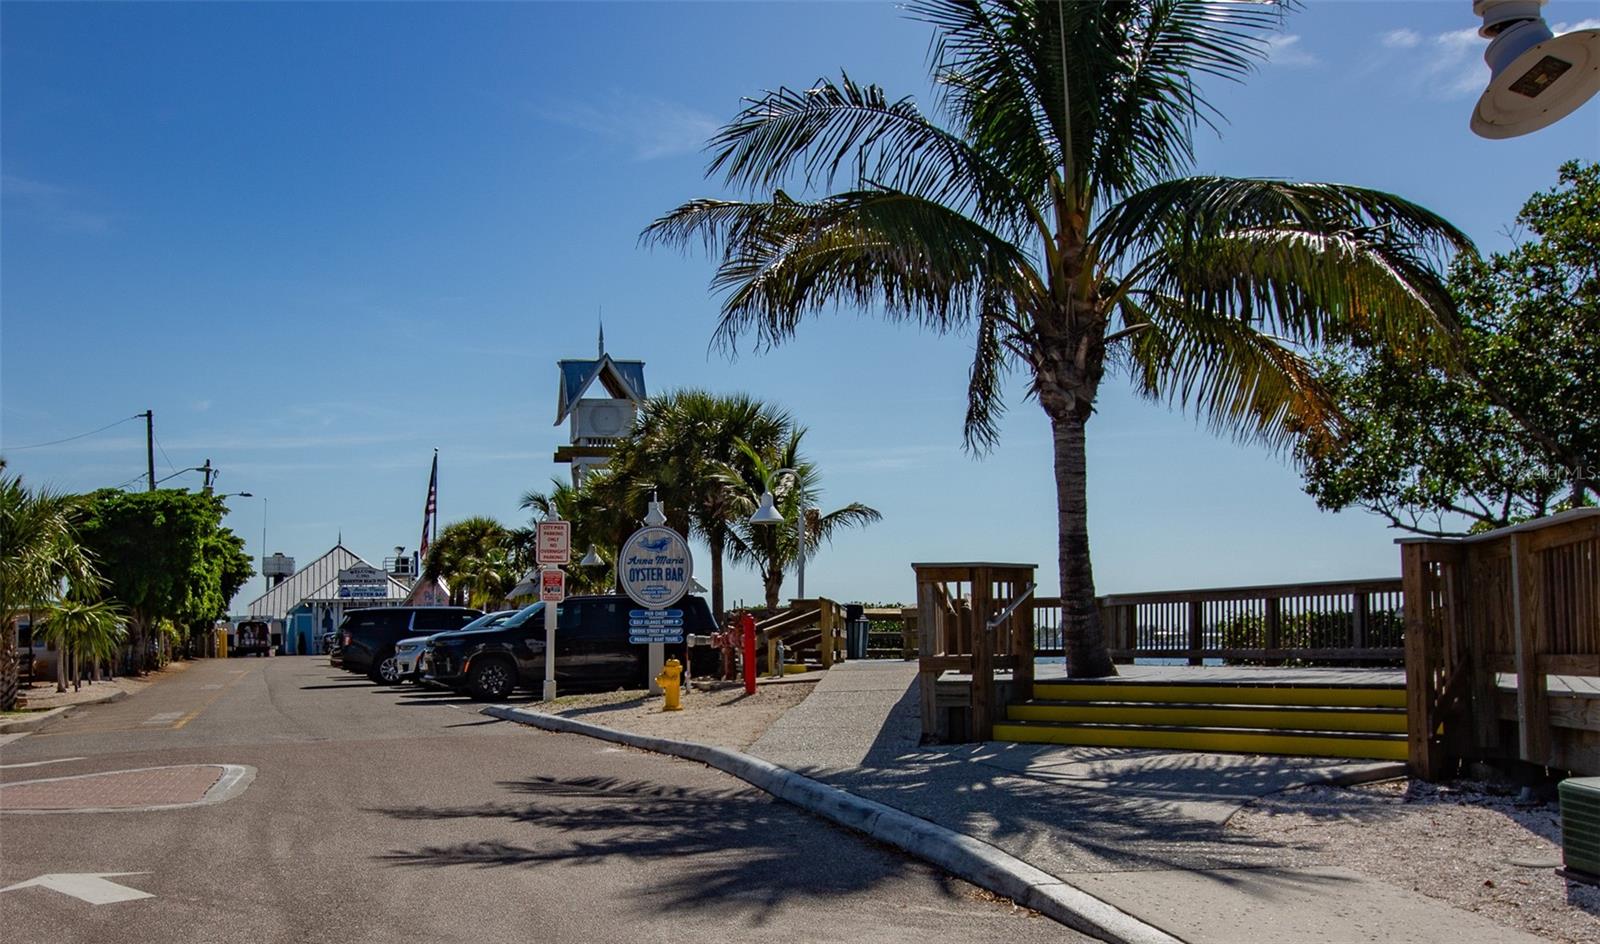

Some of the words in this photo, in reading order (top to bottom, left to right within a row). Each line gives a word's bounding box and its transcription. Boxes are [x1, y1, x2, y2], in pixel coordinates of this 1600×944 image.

[627, 556, 653, 565] Anna
[655, 555, 685, 565] Maria
[629, 567, 663, 582] OYSTER
[665, 567, 684, 582] BAR
